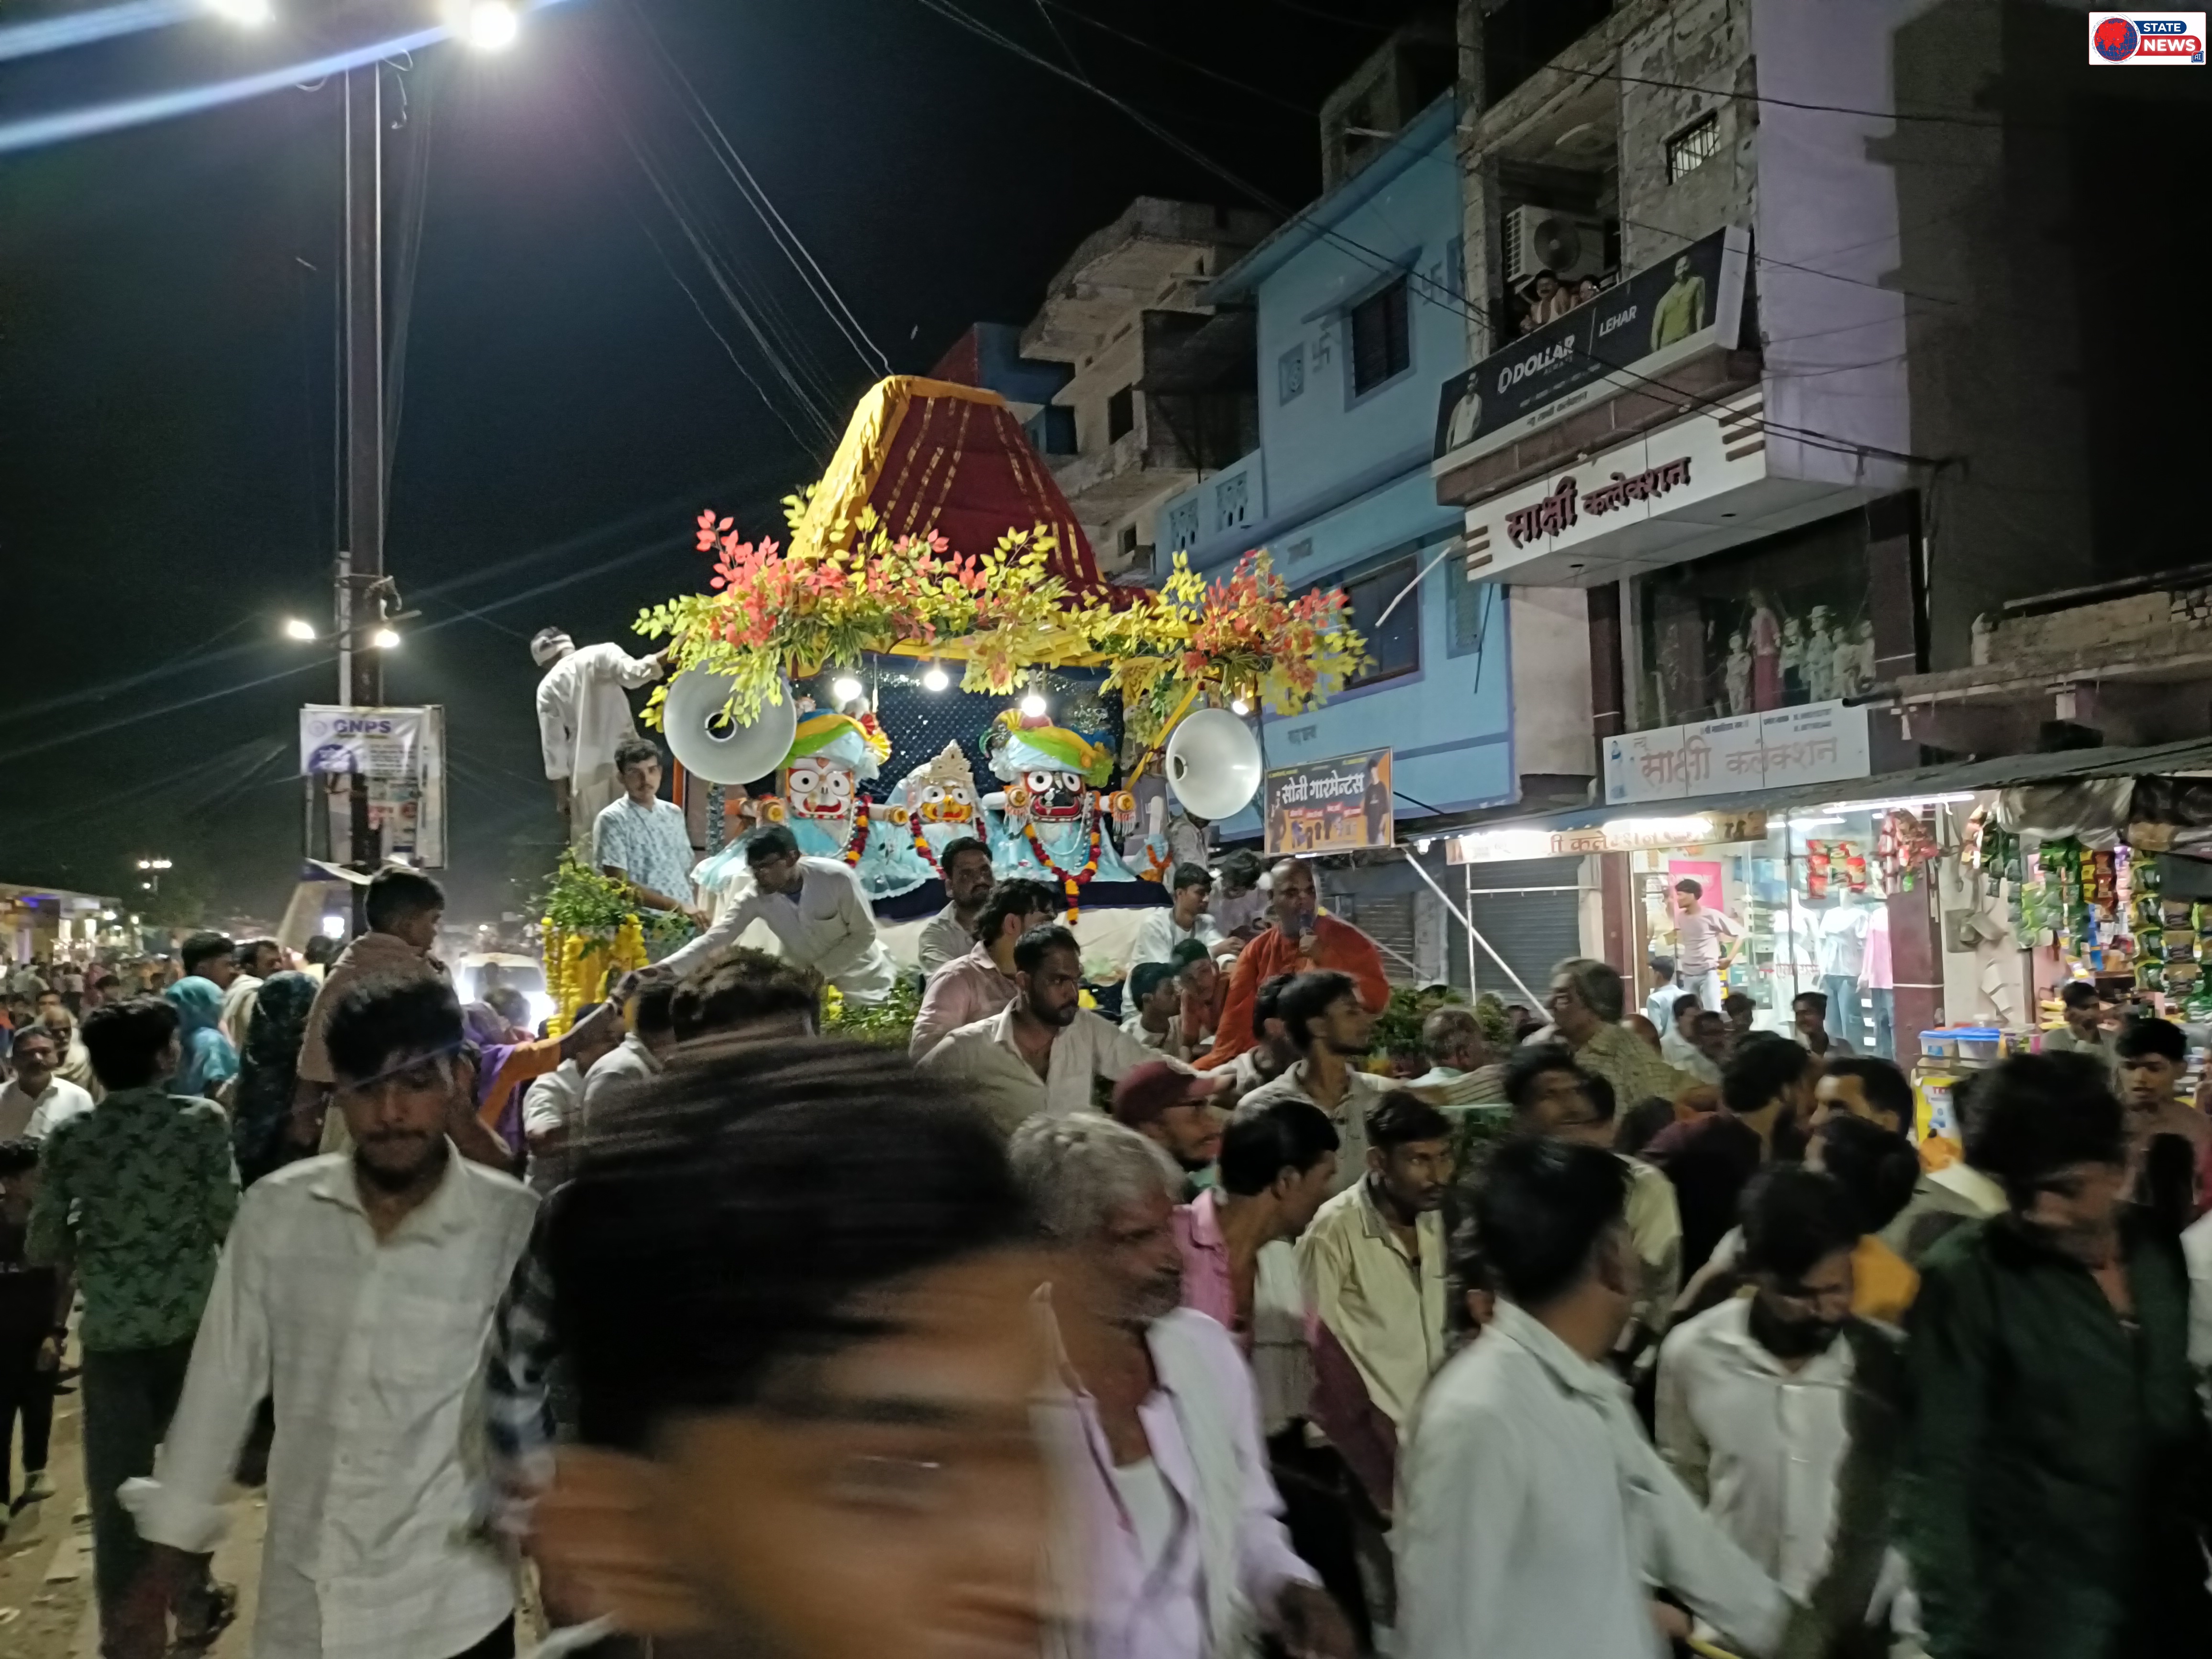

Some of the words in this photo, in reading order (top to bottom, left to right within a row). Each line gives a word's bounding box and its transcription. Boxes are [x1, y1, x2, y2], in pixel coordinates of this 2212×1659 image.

[1599, 305, 1637, 338] LEHAR
[1513, 334, 1575, 385] DOLLAR
[1505, 476, 1578, 549] साक्षी
[1581, 456, 1692, 517] कलेक्शन
[334, 719, 391, 734] GNPS
[1640, 735, 1712, 788] साक्षी
[1725, 736, 1837, 775] कलेक्शन
[1282, 774, 1308, 805] सोनी
